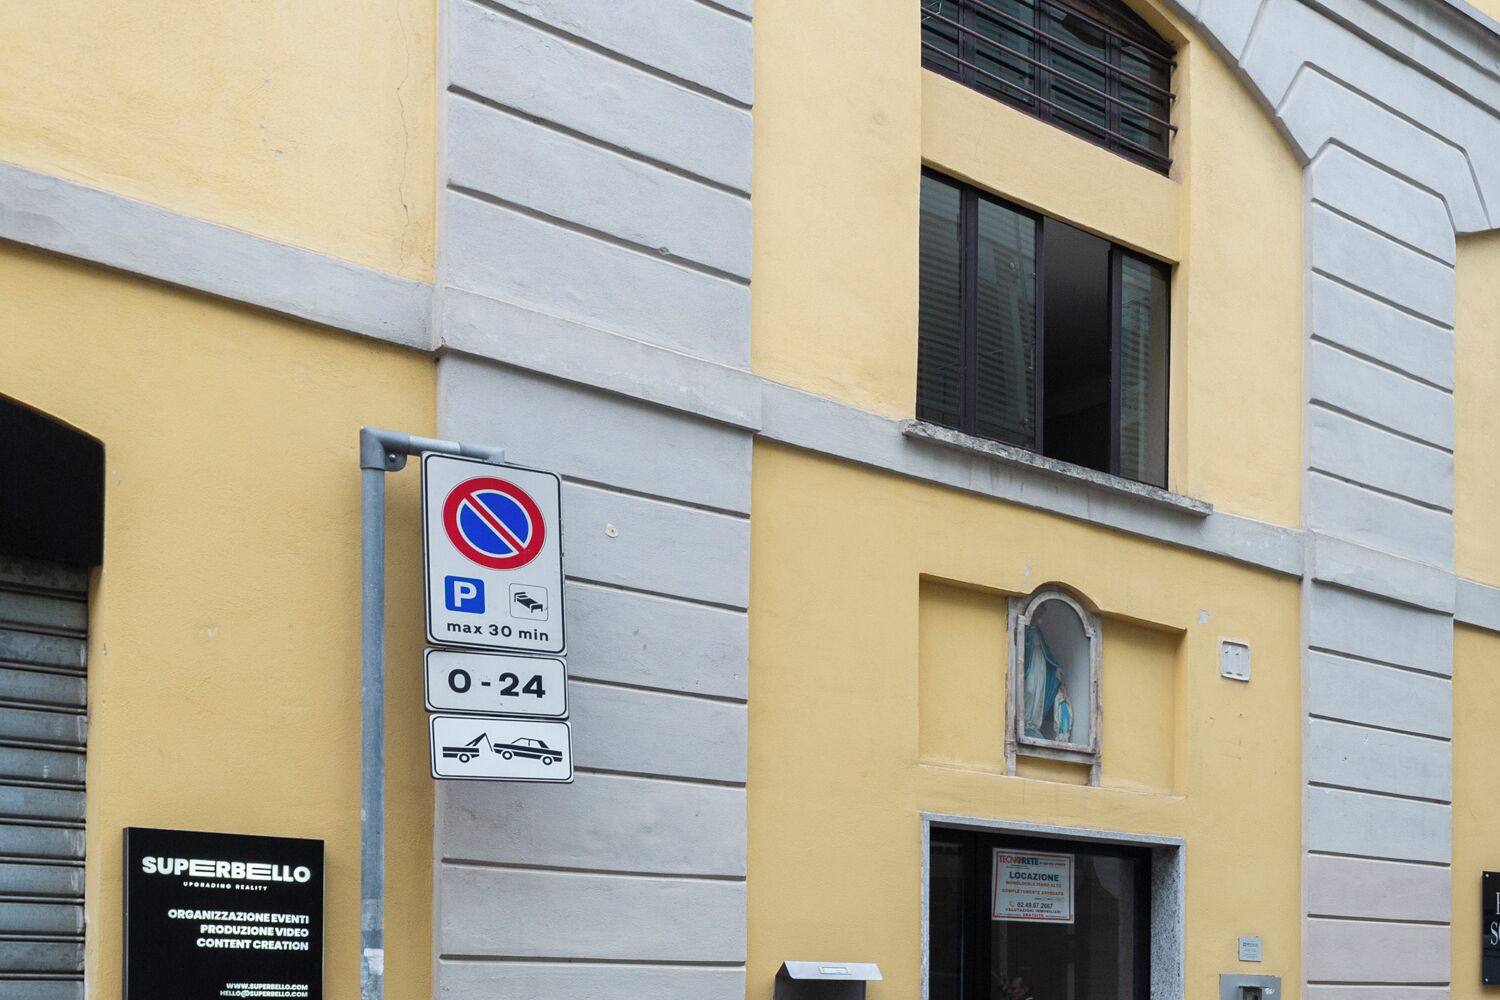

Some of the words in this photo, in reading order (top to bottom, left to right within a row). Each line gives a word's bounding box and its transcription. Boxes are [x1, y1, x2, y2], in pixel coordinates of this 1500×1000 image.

[453, 580, 477, 608] P
[447, 622, 483, 635] max
[488, 624, 512, 637] 30
[518, 629, 549, 641] min
[448, 669, 471, 693] 0
[499, 672, 546, 698] 24
[141, 856, 311, 883] SUPERBELLO
[1009, 872, 1060, 881] LOCAZIONE
[183, 881, 232, 891] UPGRADING
[168, 908, 270, 923] ORGANIZZAZIONE
[271, 913, 309, 924] EVENTI
[200, 924, 274, 937] PRODUZIONE
[275, 927, 309, 937] VIDEO
[196, 938, 252, 949] CONTENT
[252, 940, 309, 951] CREATION
[226, 982, 308, 991] WWW.SUPERBELLO.COM
[220, 989, 308, 998] HELLO@SUPERBELLO.COM
